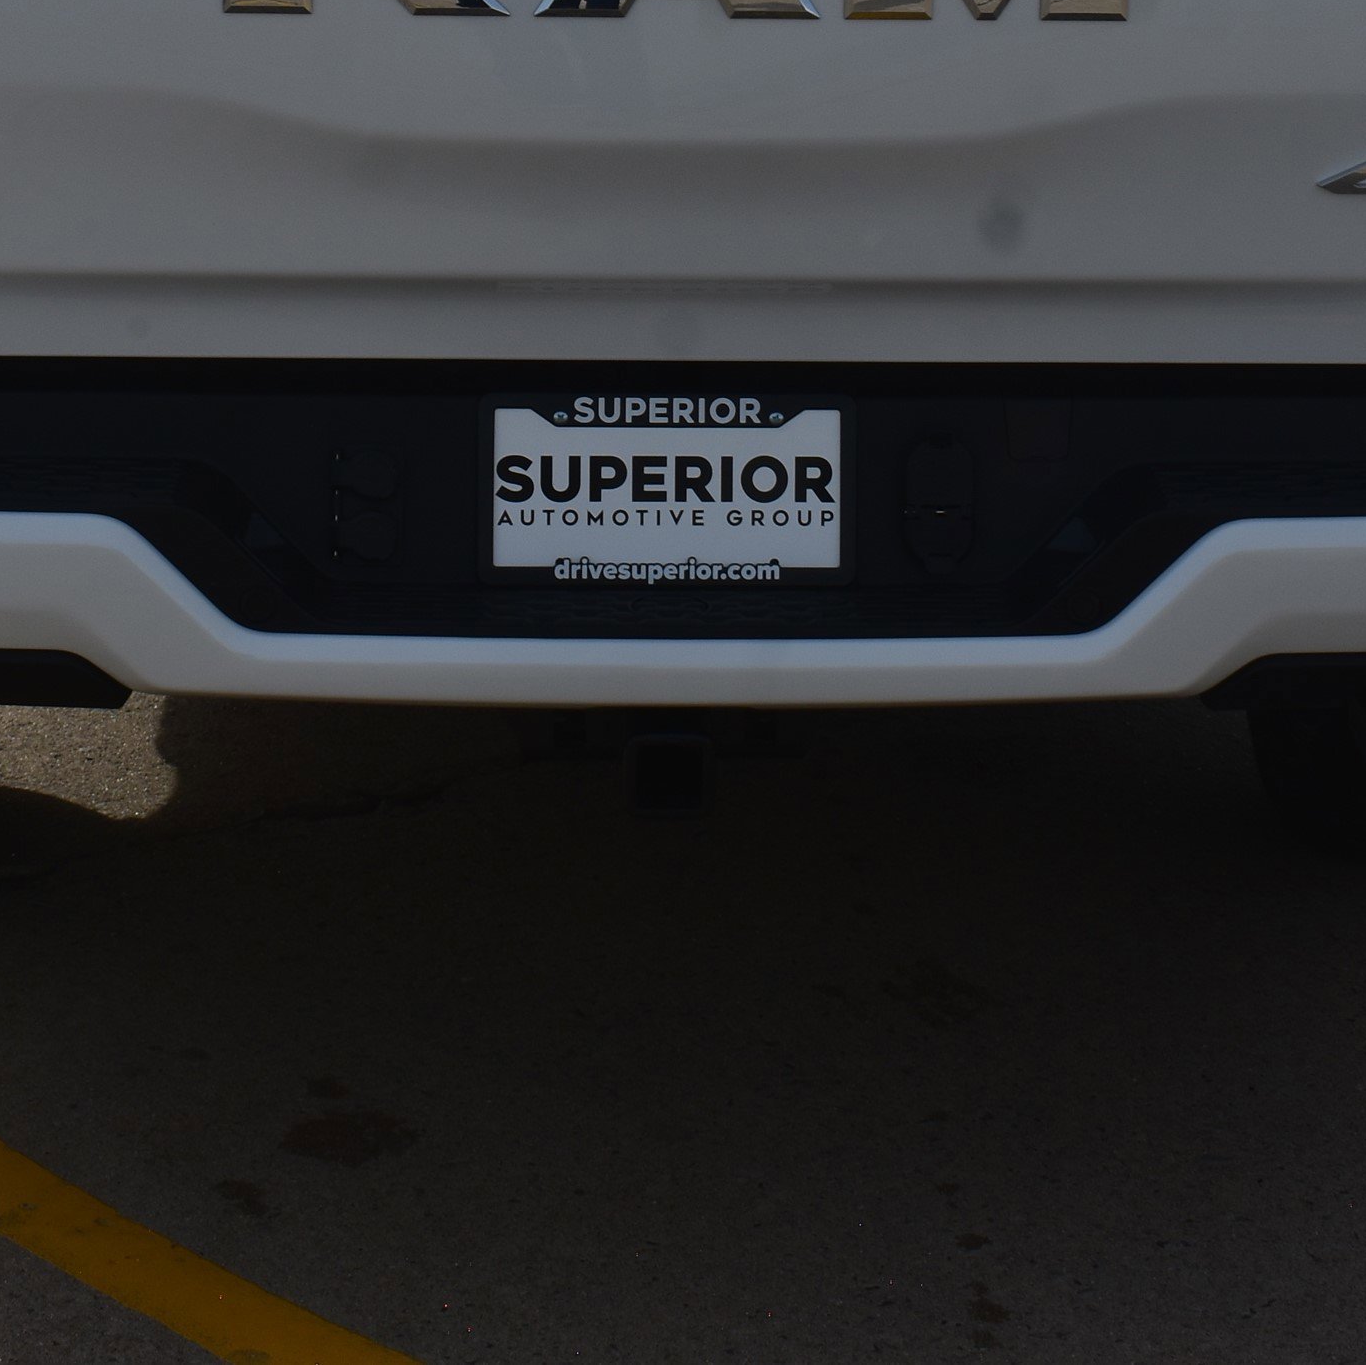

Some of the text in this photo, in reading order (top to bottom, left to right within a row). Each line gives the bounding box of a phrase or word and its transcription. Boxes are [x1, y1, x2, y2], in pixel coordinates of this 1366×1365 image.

[573, 396, 762, 424] SUPERIOR
[495, 454, 836, 504] SUPERIOR
[497, 509, 835, 527] AUTOMOTIVE GROUP
[553, 556, 781, 585] drivesuperior.com
